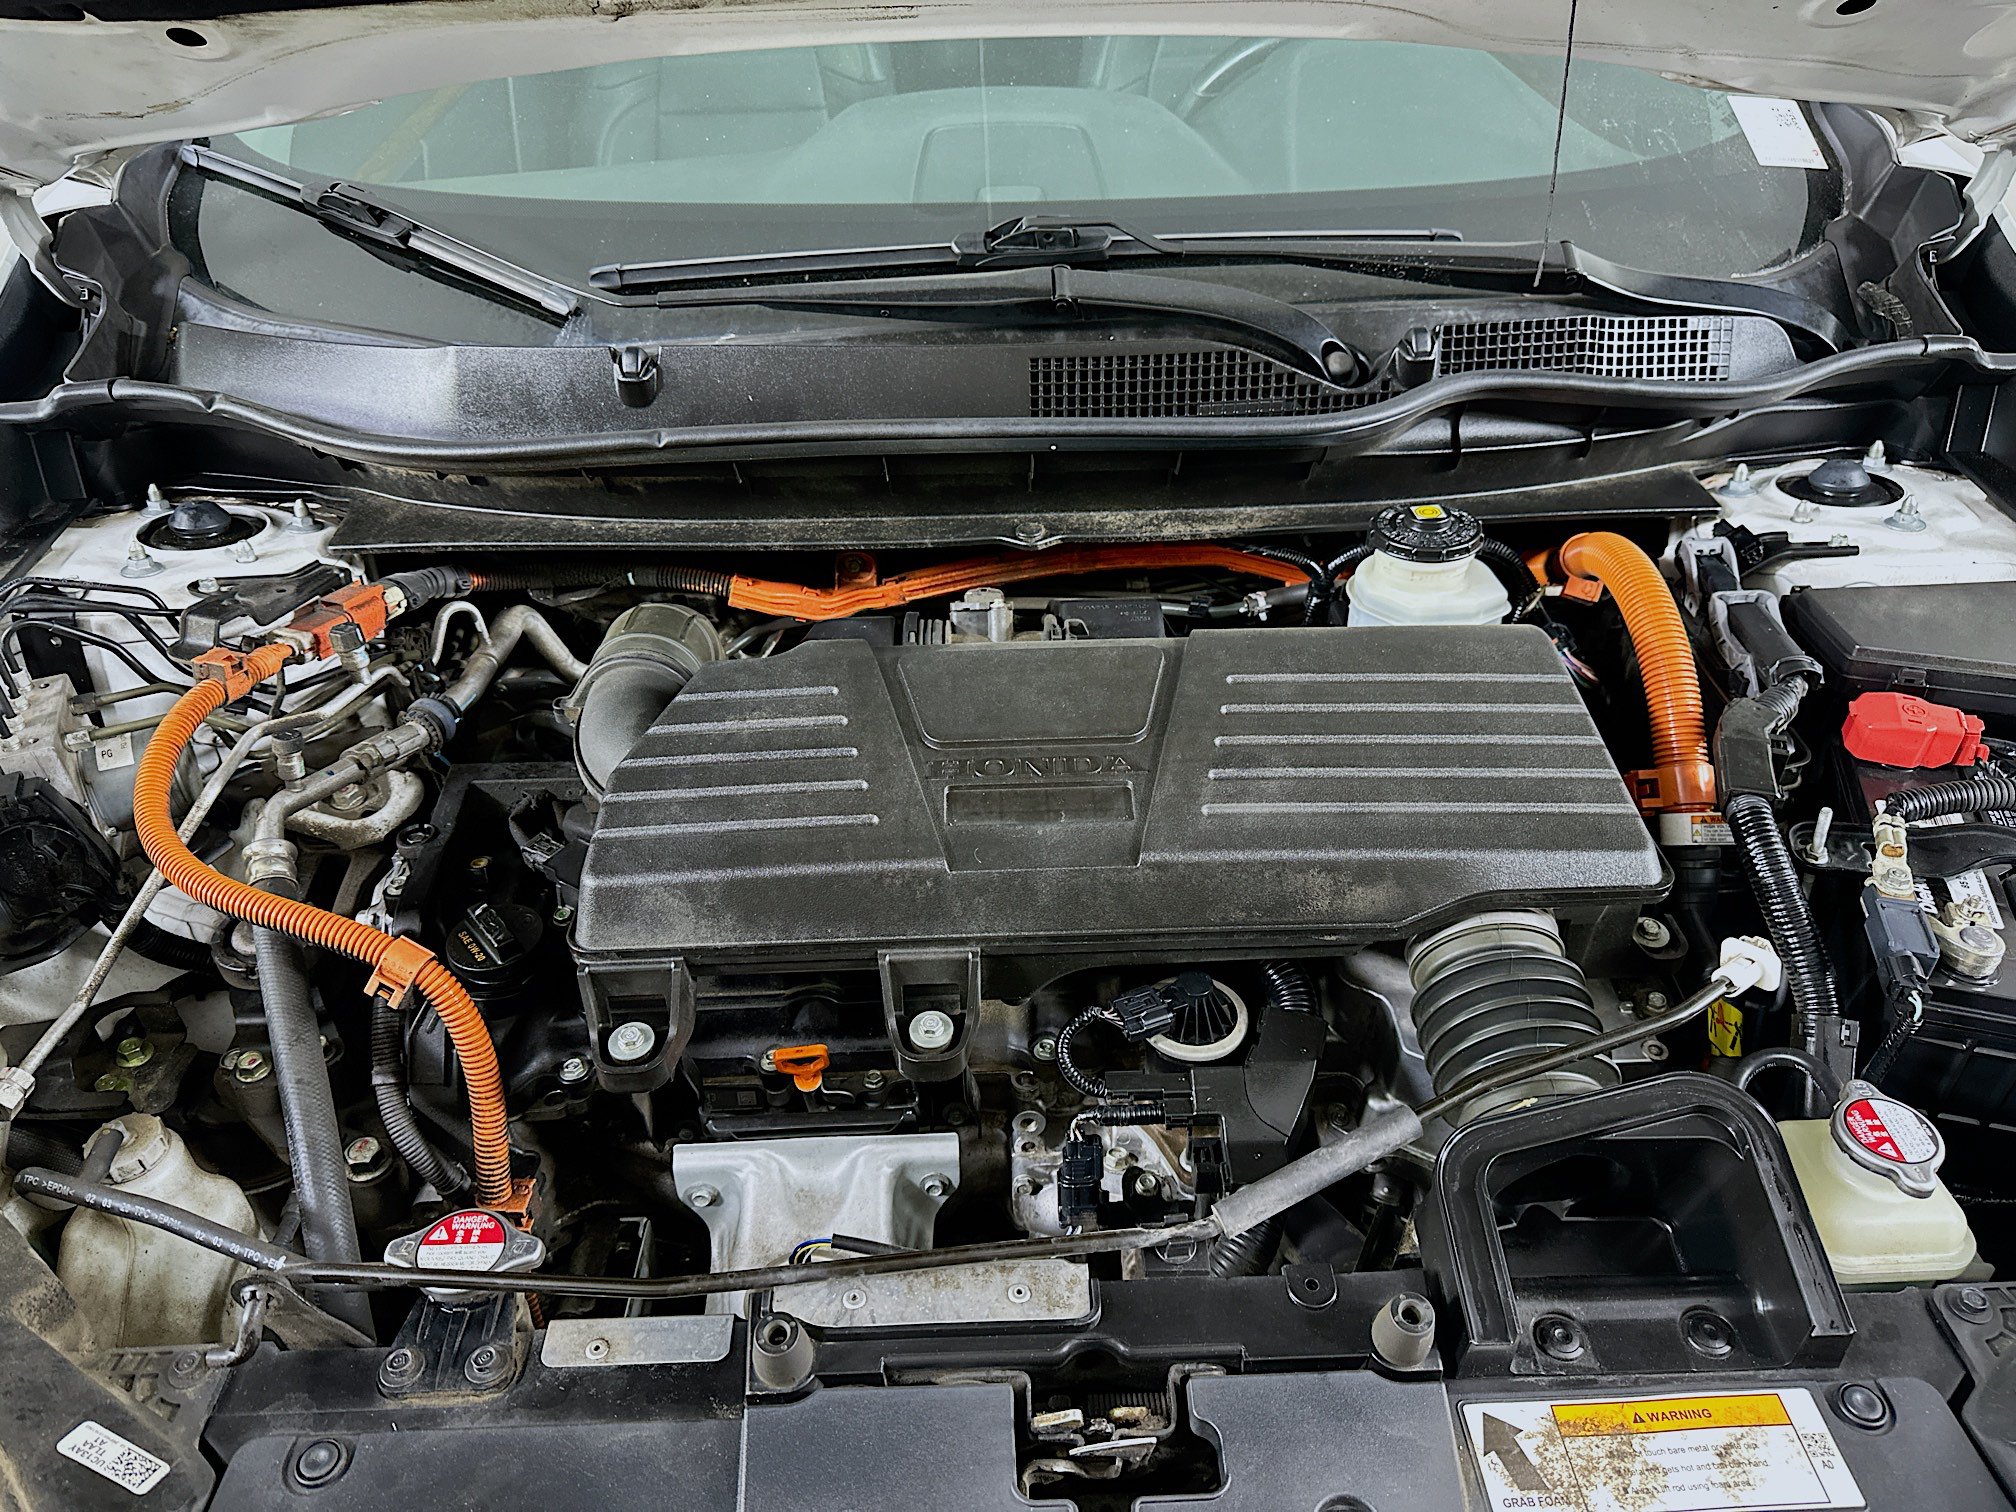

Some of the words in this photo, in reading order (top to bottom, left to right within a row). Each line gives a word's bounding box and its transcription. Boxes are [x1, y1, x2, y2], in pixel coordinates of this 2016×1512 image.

[101, 749, 113, 759] PG
[926, 754, 1149, 780] HONDA
[457, 930, 473, 946] SAE
[467, 942, 487, 962] 0W-20
[23, 1174, 40, 1186] TPC
[84, 1192, 97, 1205] 02
[101, 1198, 112, 1209] 03
[194, 1230, 207, 1241] 02
[212, 1236, 224, 1248] 03
[229, 1242, 240, 1255] 20
[243, 1247, 261, 1261] TPC
[453, 1215, 490, 1223] DANGER
[452, 1222, 496, 1230] WARNUNG
[1646, 1408, 1712, 1422] WARNING
[1643, 1447, 1667, 1457] touch
[1667, 1446, 1686, 1455] bare
[1687, 1444, 1710, 1453] metal
[1711, 1444, 1719, 1452] or
[1661, 1465, 1680, 1477] gets
[1680, 1463, 1694, 1472] hot
[1696, 1462, 1711, 1471] and
[1672, 1483, 1686, 1492] rod
[1688, 1481, 1711, 1493] using
[1502, 1496, 1536, 1508] GRAB
